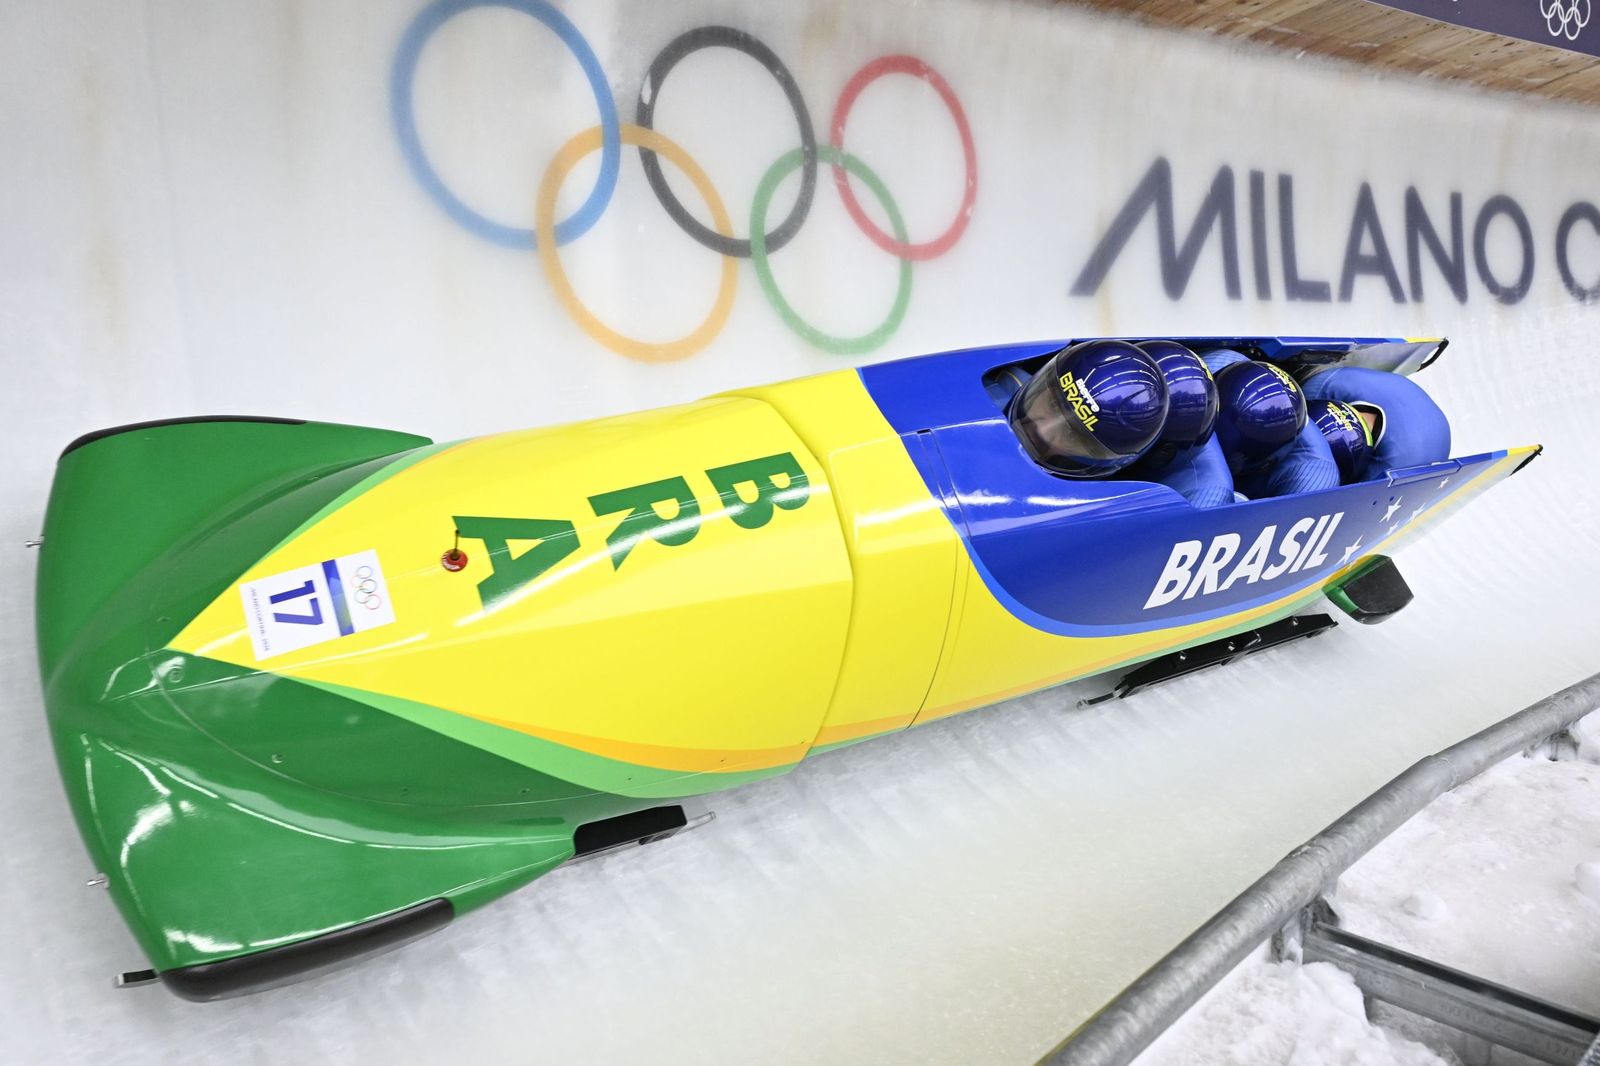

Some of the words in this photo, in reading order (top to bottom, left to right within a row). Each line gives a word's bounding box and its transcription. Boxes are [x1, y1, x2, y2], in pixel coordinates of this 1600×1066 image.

[1068, 156, 1535, 305] MILANO
[1060, 371, 1099, 432] BRASIL
[1143, 512, 1344, 610] BRASIL
[269, 579, 324, 626] 17
